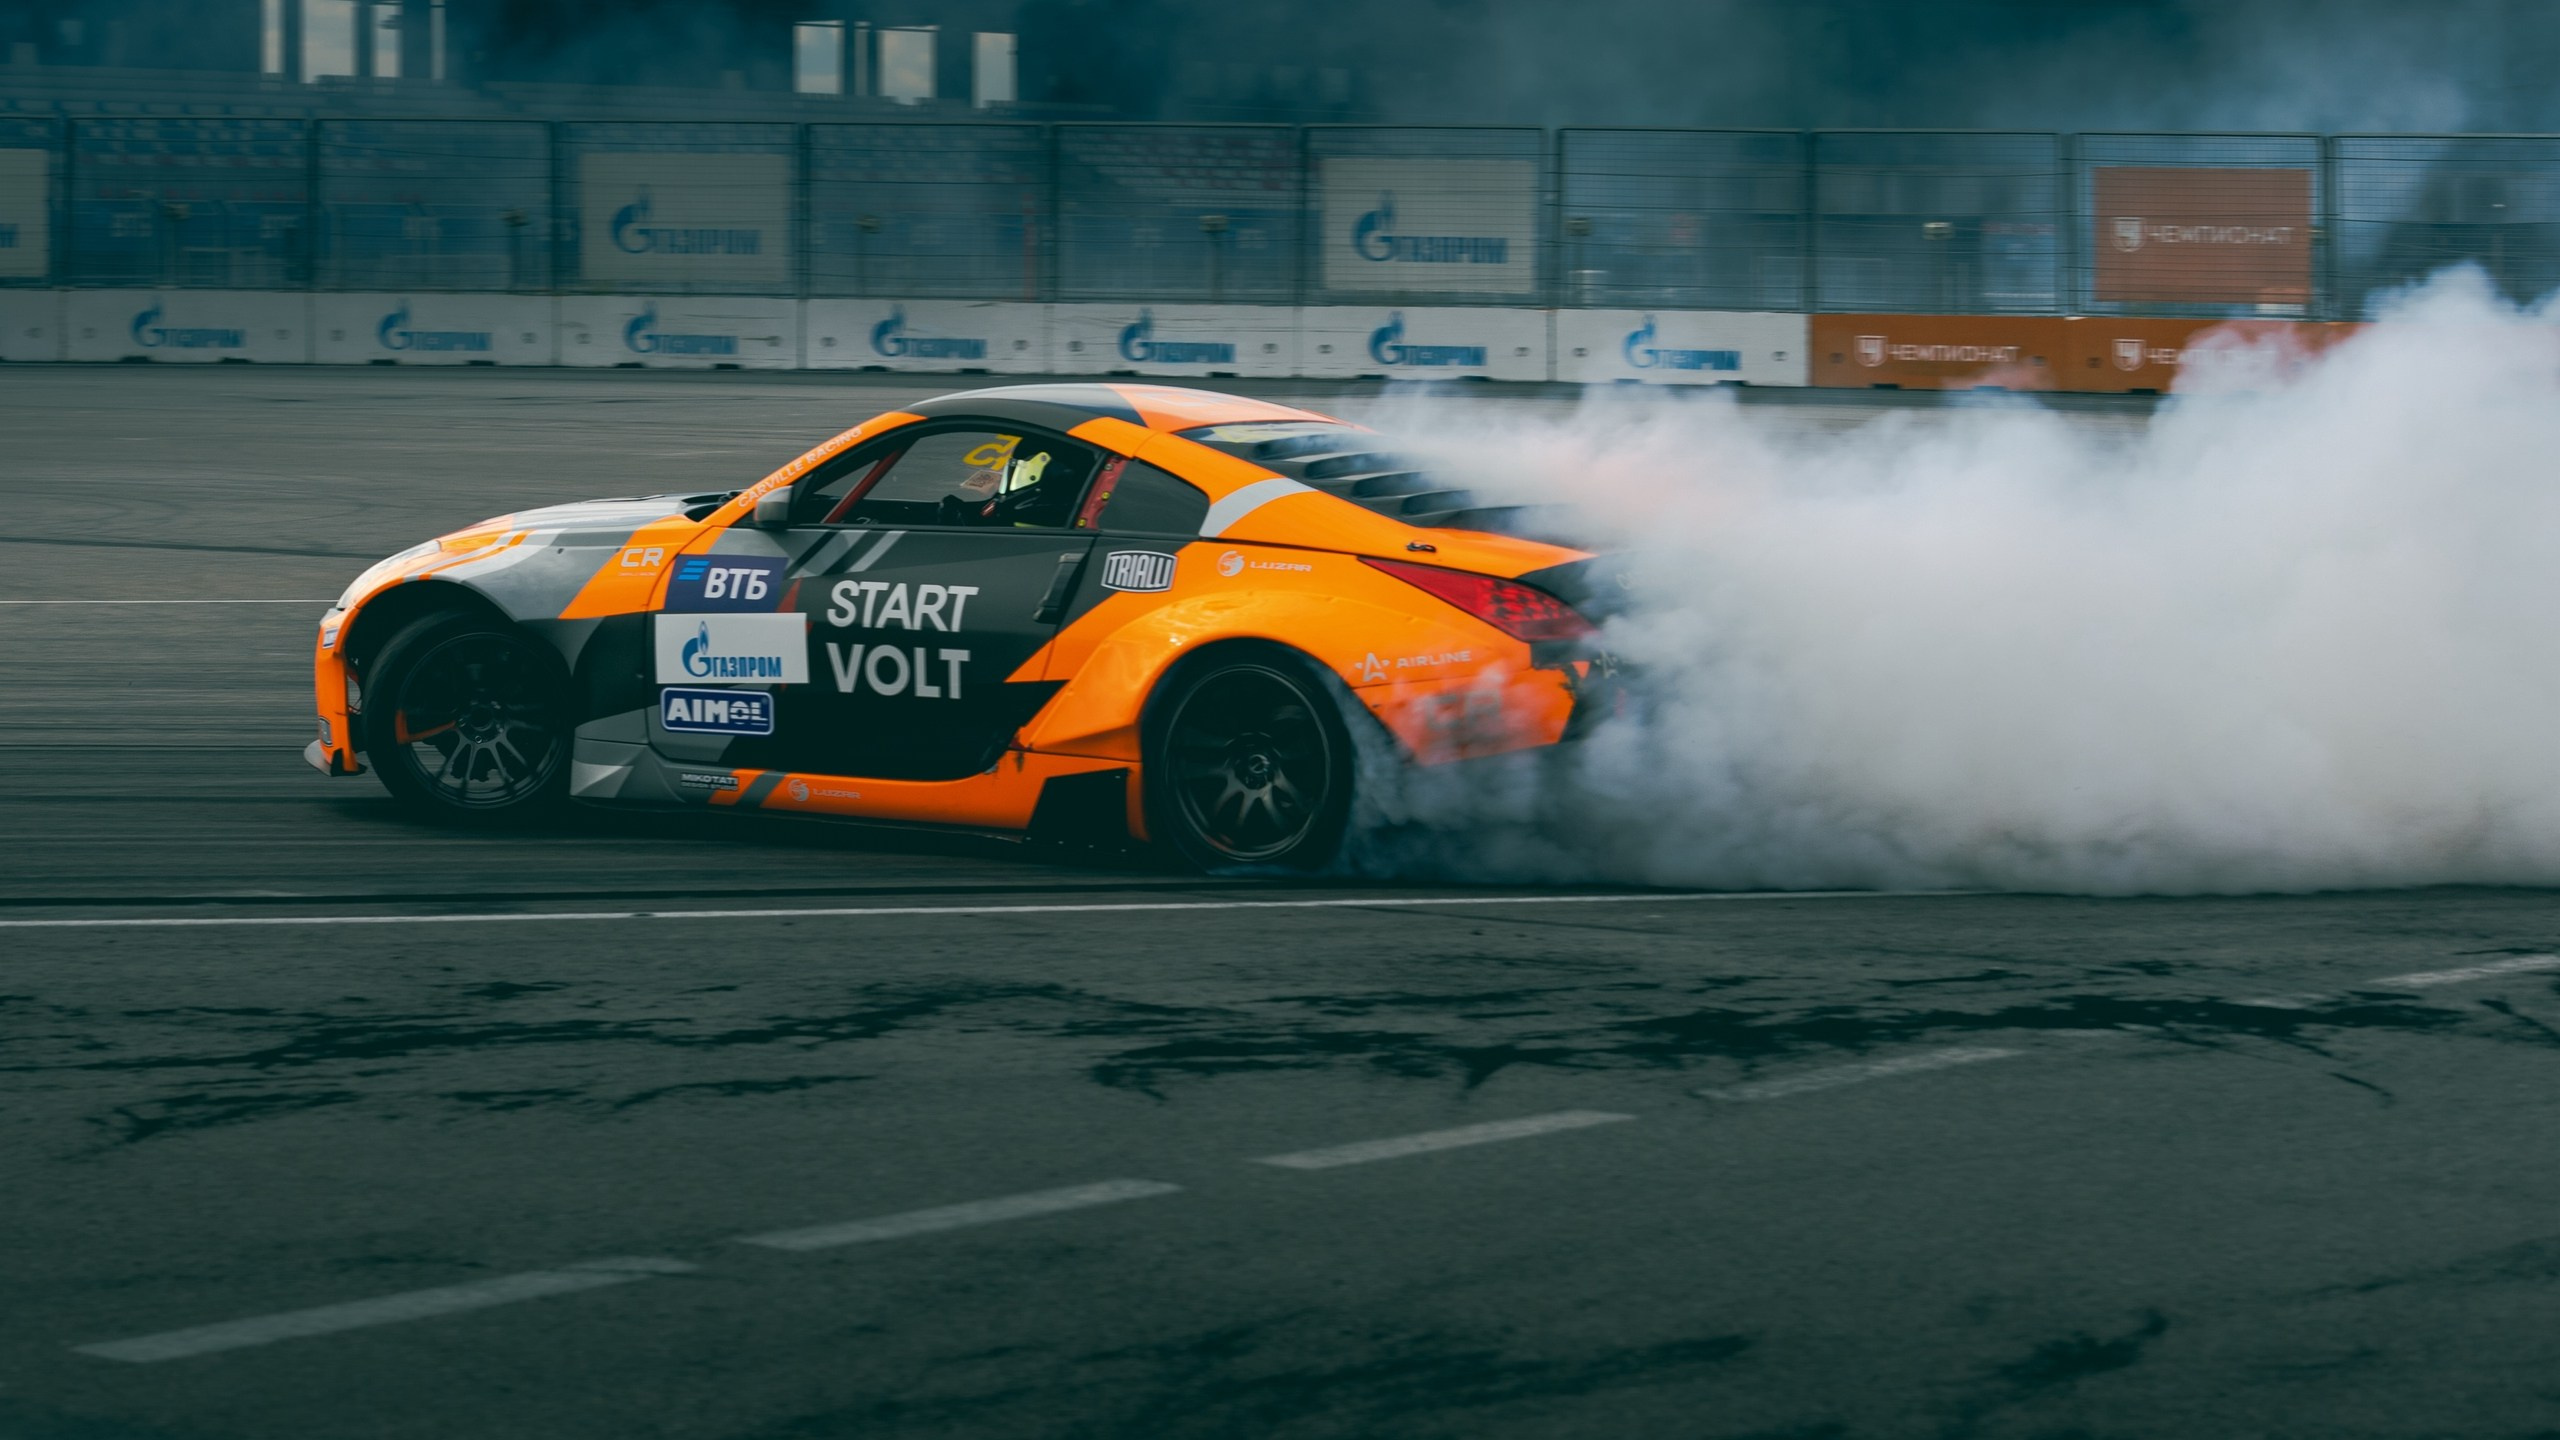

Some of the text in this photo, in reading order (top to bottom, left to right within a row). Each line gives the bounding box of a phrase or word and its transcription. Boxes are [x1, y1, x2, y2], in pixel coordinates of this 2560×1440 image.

[806, 427, 862, 464] RACING
[620, 547, 665, 568] CR
[1250, 561, 1312, 572] LUZAR
[704, 567, 771, 600] ВТБ
[827, 580, 979, 632] START
[713, 656, 782, 678] ГАЗПРОМ
[826, 642, 971, 699] VOLT
[1396, 650, 1473, 668] AIRLINE
[666, 697, 769, 726] AIMOL
